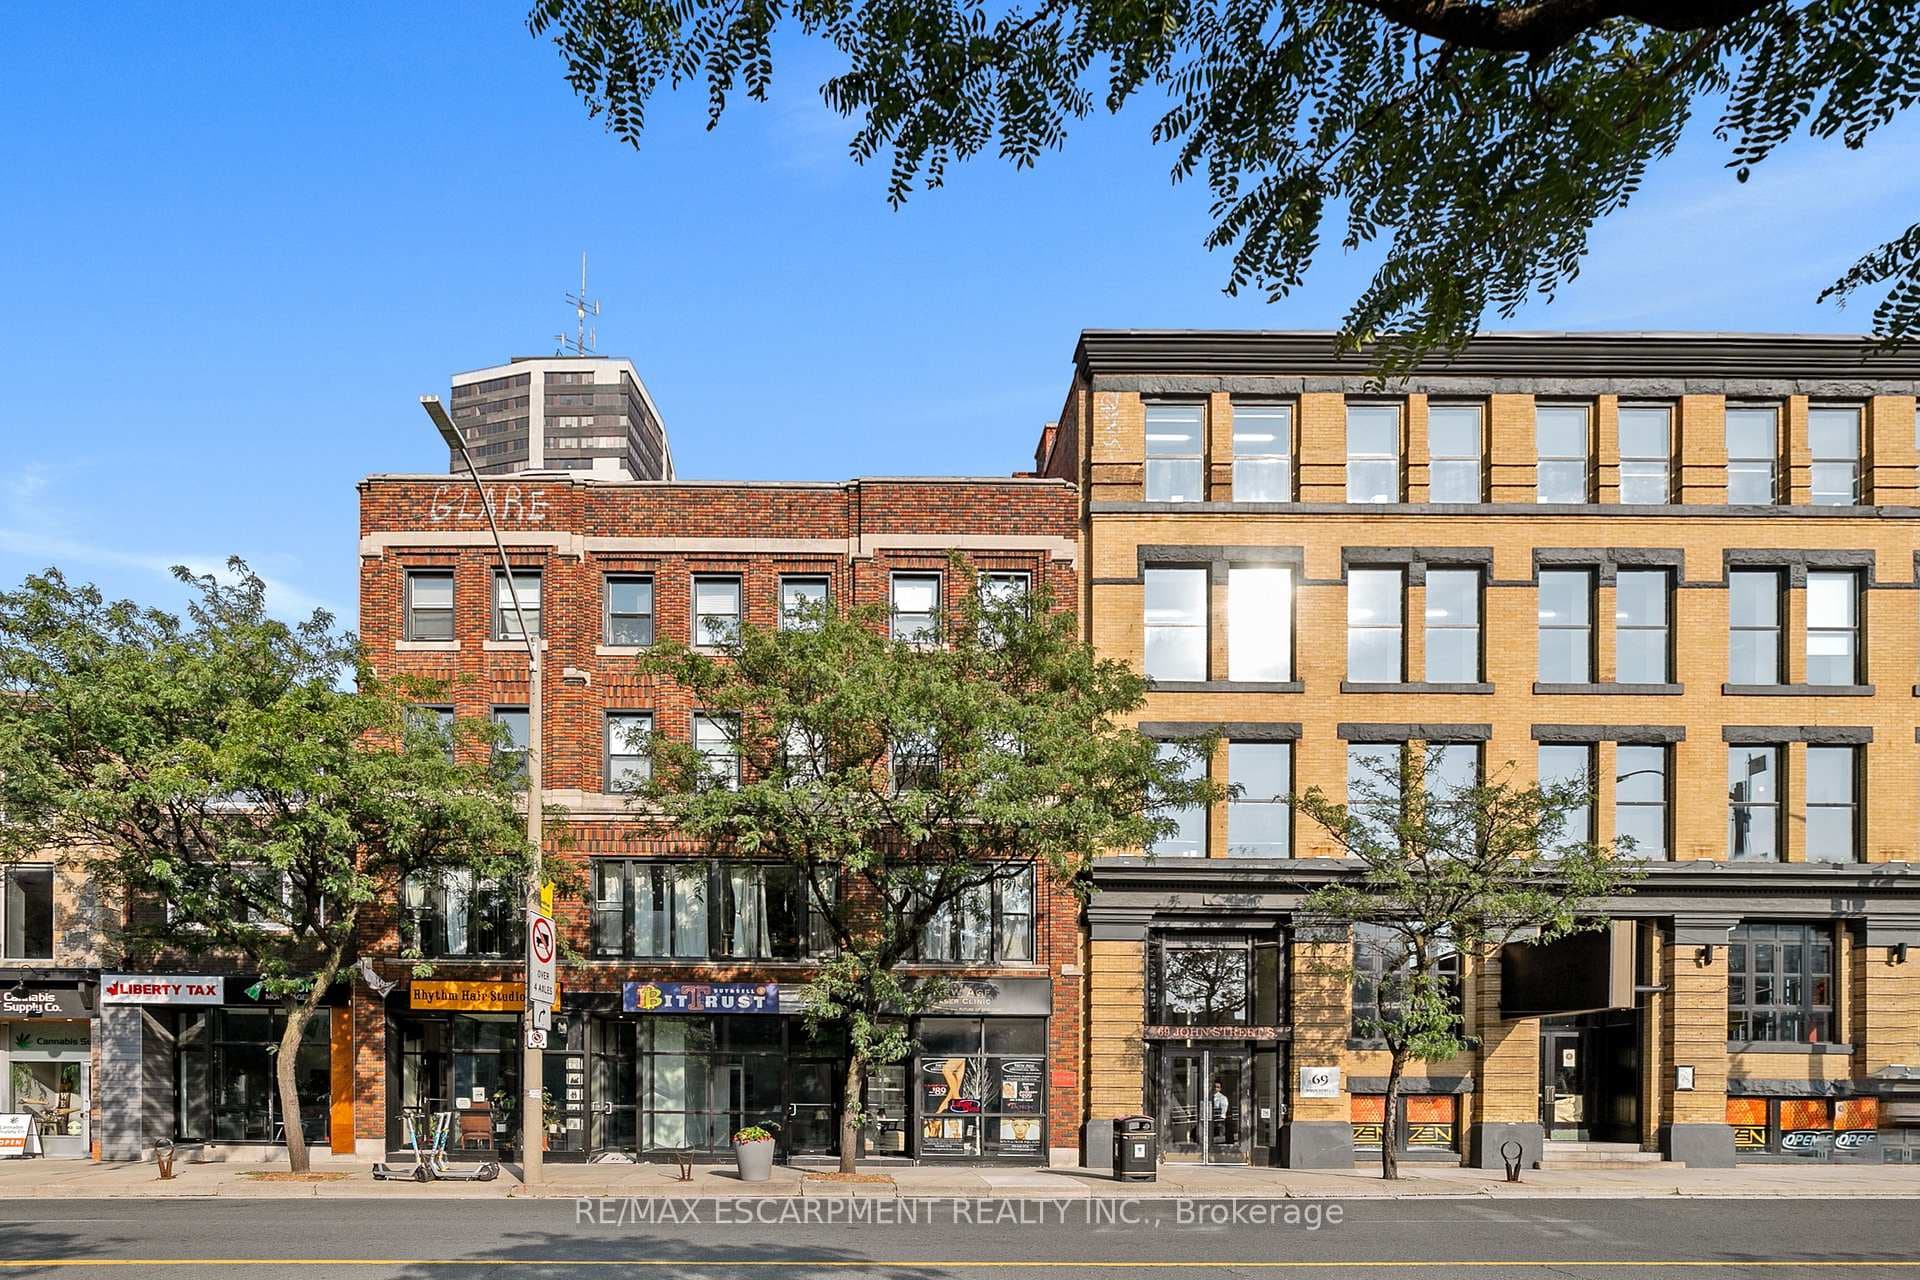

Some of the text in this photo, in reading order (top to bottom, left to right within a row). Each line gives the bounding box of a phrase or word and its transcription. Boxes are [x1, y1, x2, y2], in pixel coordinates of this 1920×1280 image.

[120, 984, 217, 996] LIBERTY TAX
[3, 991, 56, 1002] Caabis
[413, 989, 525, 1004] Rhythm Hair Studio
[3, 1002, 63, 1014] Supply Co.
[1157, 1026, 1170, 1037] 69
[1173, 1026, 1210, 1037] JOHN
[1211, 1026, 1264, 1037] STREET
[36, 1037, 79, 1046] Cannabis
[1311, 1074, 1329, 1087] 69
[1408, 1126, 1452, 1141] ZEN
[1735, 1129, 1766, 1144] EN
